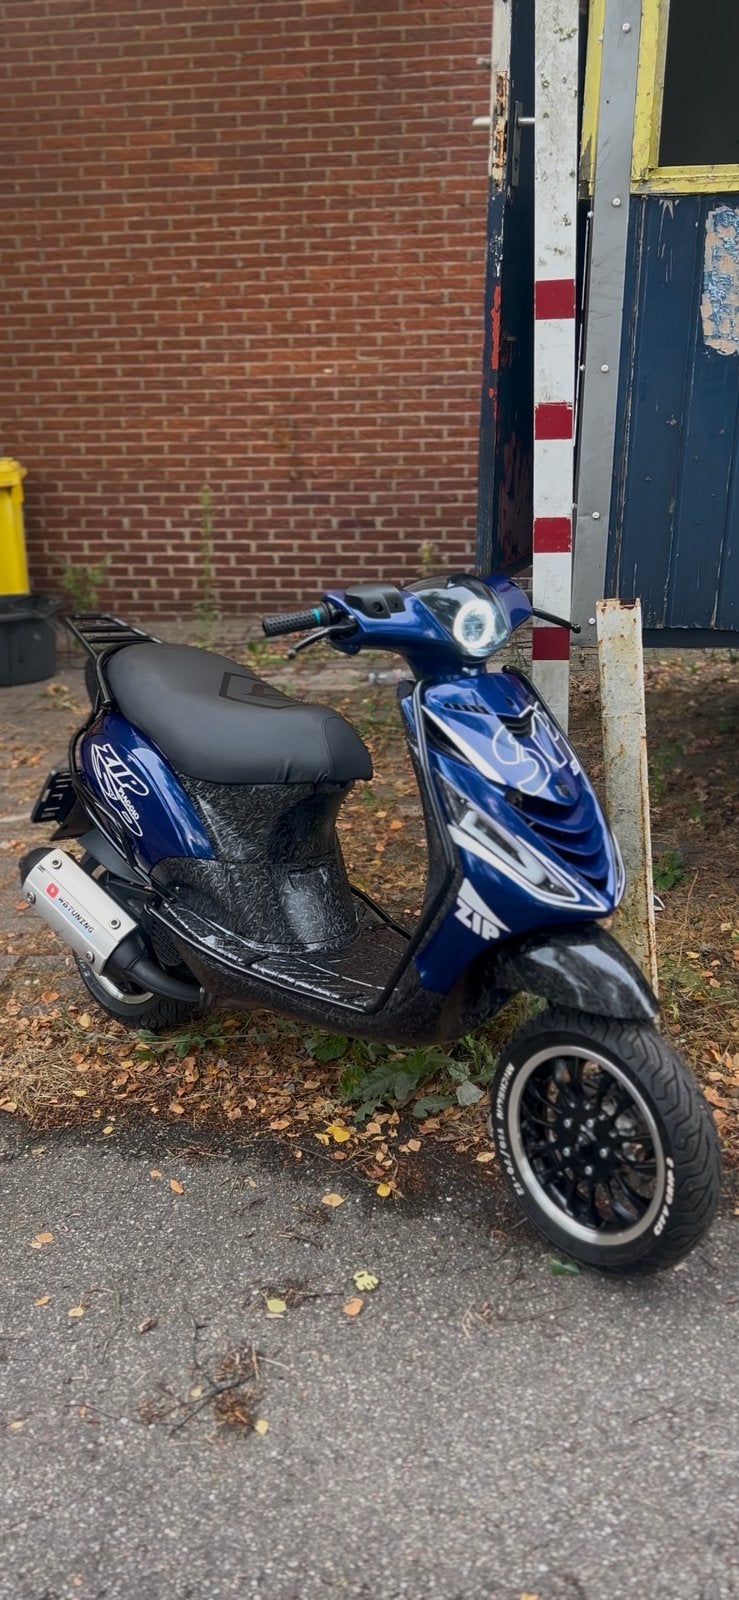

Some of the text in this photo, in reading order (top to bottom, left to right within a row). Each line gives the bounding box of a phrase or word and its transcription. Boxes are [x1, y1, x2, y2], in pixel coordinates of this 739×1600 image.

[94, 743, 149, 796] ZIP
[118, 787, 140, 820] PIAGGIO
[453, 896, 501, 941] ZIP
[496, 1062, 525, 1196] MICHELIN 110/70-12
[653, 1204, 669, 1236] CITY
[665, 1169, 675, 1205] GRIP
